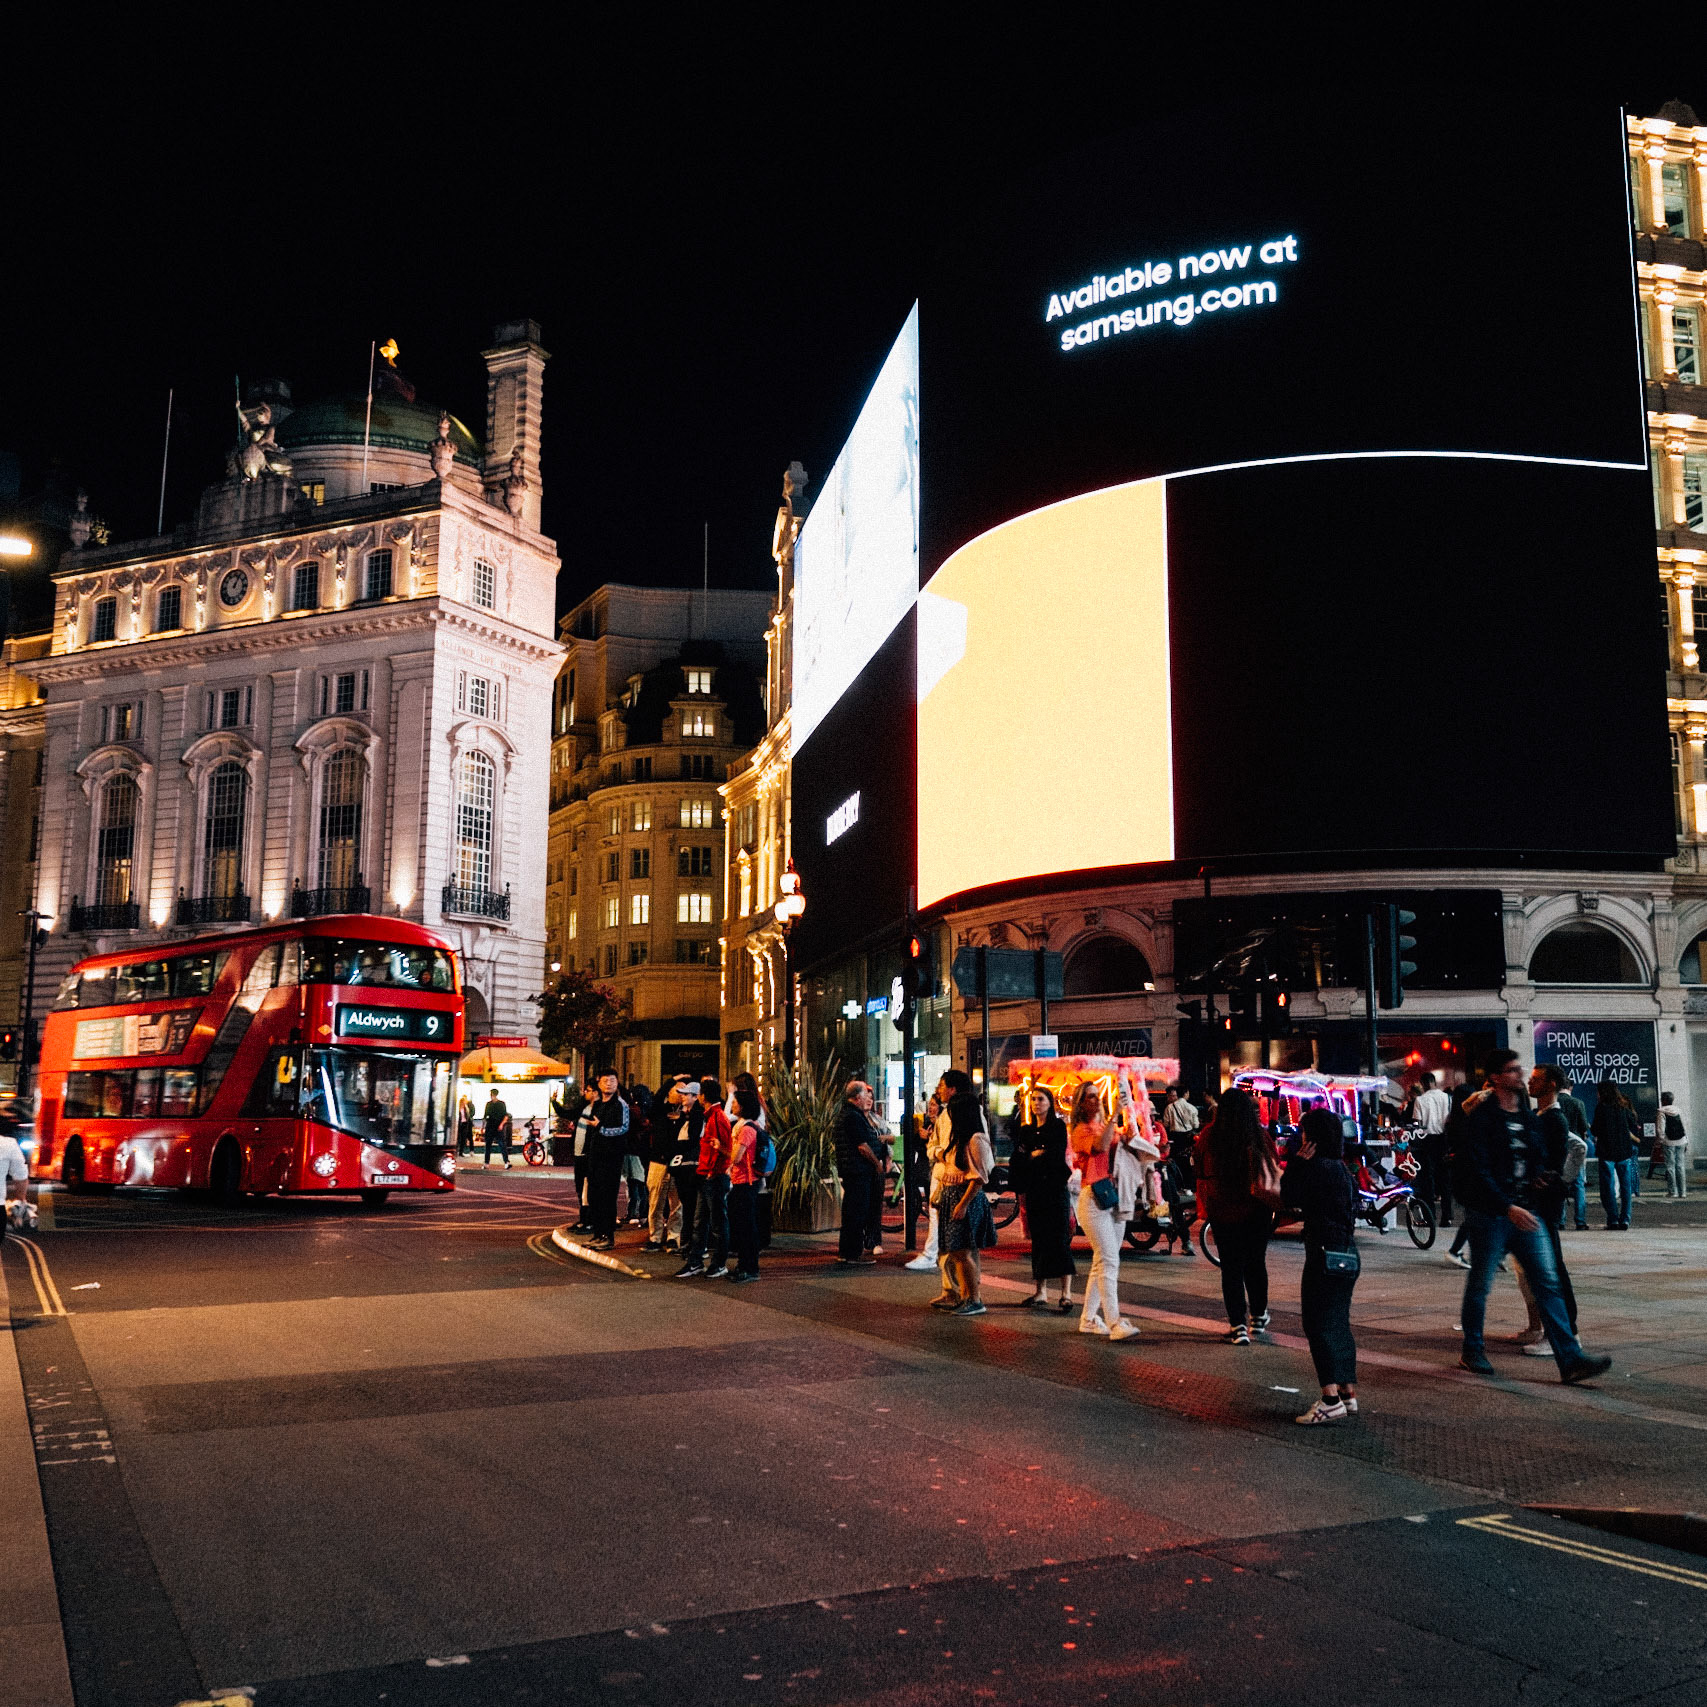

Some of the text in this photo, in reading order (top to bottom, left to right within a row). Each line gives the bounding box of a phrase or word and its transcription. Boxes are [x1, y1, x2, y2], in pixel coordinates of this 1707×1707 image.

[1046, 234, 1297, 322] Available now at
[1060, 280, 1277, 351] samsung.com
[348, 1011, 439, 1035] Aldwych 9
[1062, 1040, 1148, 1057] ILLUMINATED
[1546, 1032, 1596, 1048] PRIME
[1557, 1051, 1640, 1069] retail space
[1567, 1068, 1649, 1084] AVAILABLE
